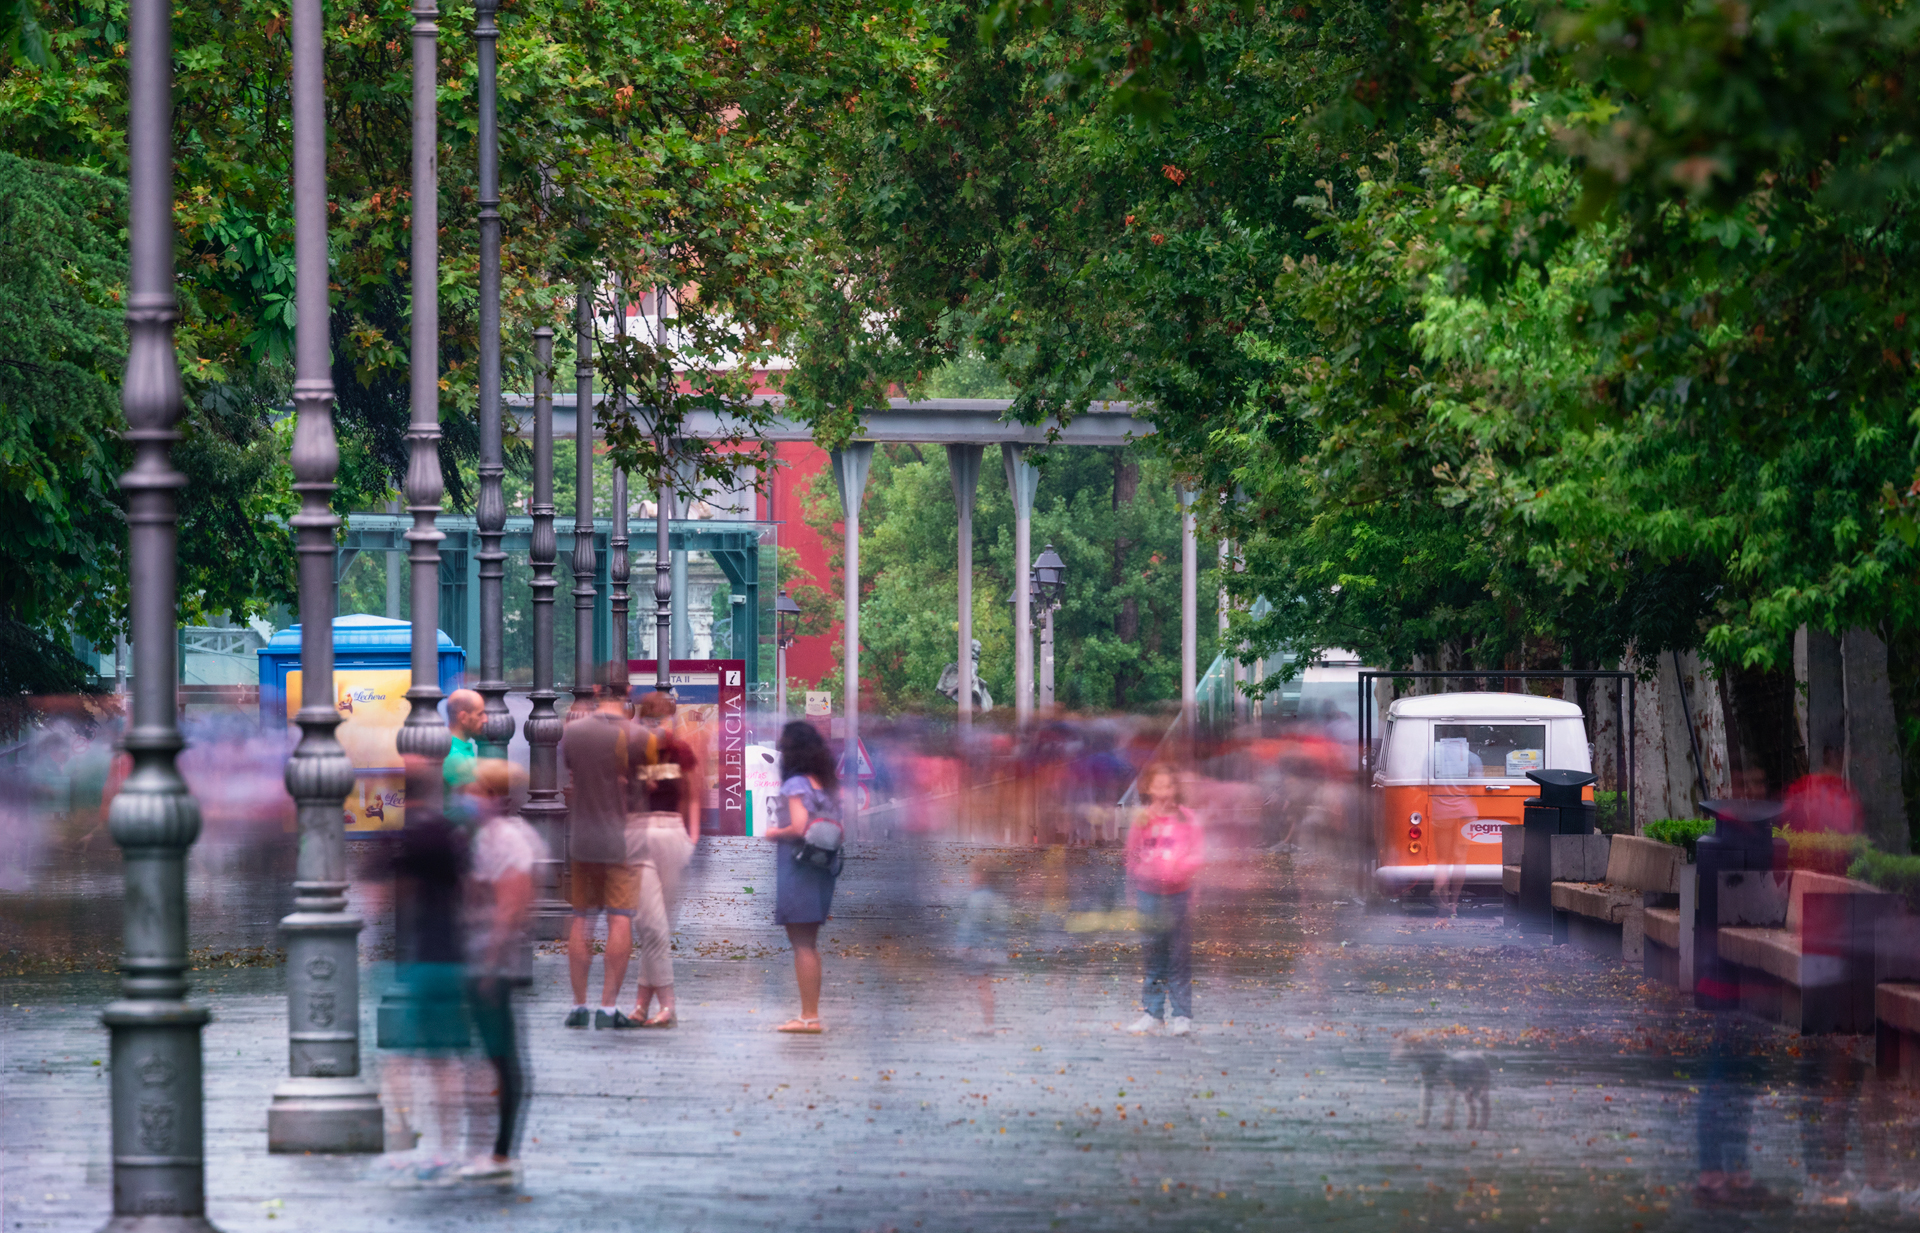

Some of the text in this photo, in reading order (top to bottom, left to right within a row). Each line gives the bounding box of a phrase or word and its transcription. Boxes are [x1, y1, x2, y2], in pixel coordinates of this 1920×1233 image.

[355, 691, 386, 703] Lechera
[725, 694, 742, 811] PALENCIA
[1470, 824, 1502, 834] regm
